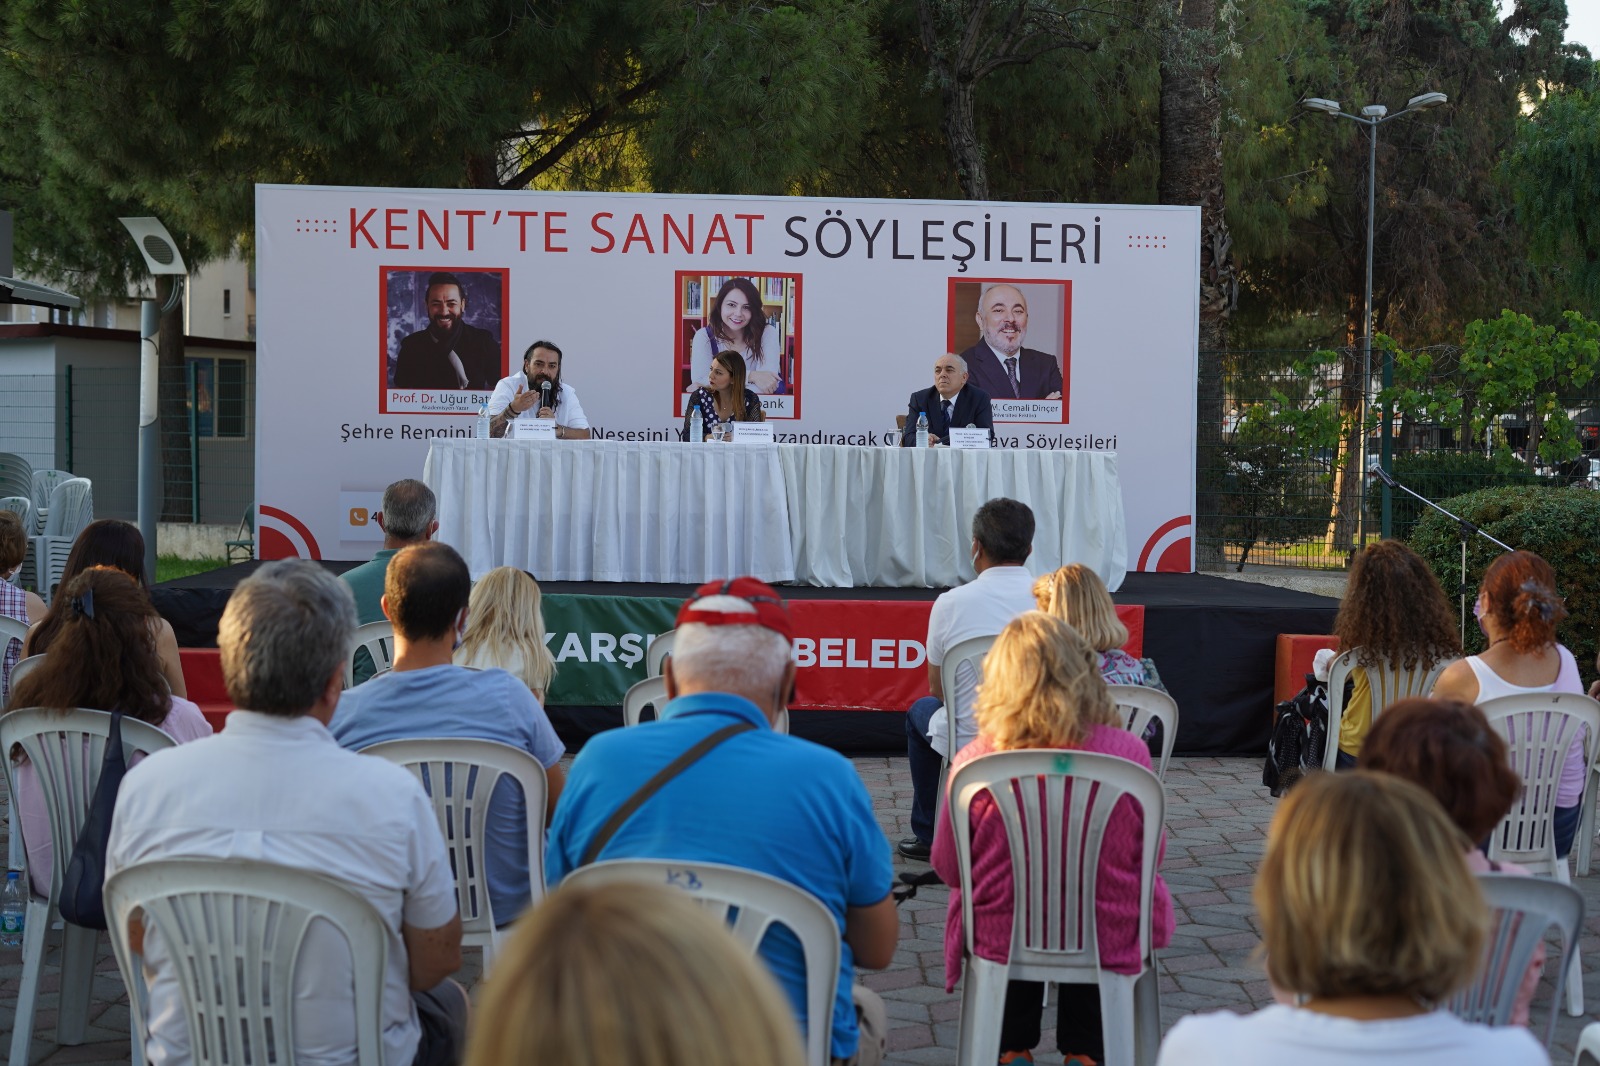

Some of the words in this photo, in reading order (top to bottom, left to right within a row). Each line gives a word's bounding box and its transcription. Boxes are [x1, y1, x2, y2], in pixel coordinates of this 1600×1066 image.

[349, 207, 568, 253] KENT'TE
[590, 211, 765, 255] SANAT
[784, 209, 1102, 273] SÖYLEŞİLERİ
[392, 393, 418, 403] Prof.
[421, 393, 437, 404] Dr.
[440, 394, 468, 406] Uğur
[1002, 403, 1030, 412] Cemali
[1032, 404, 1059, 414] Dinçer
[341, 423, 394, 442] Şehre
[772, 430, 878, 446] azandıracak
[1026, 433, 1117, 450] Söyleşileri
[791, 637, 927, 669] BELED
